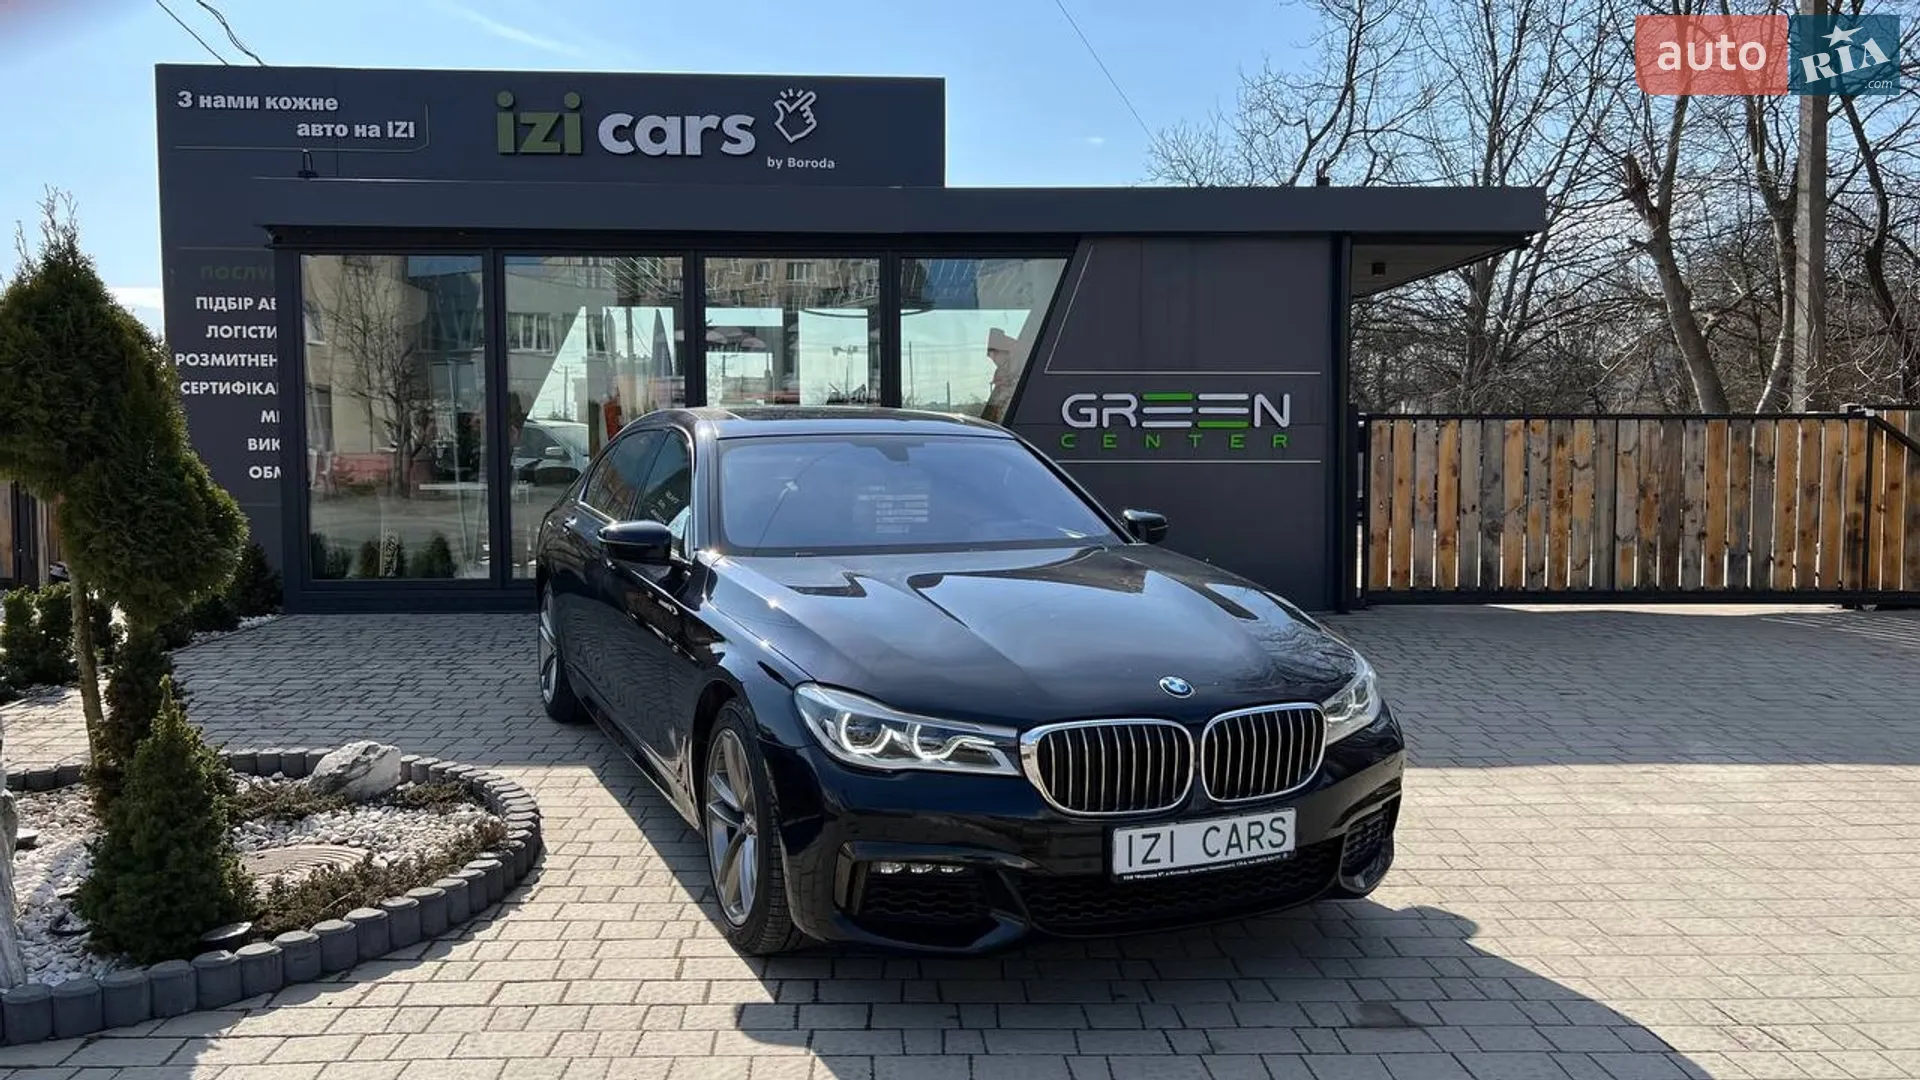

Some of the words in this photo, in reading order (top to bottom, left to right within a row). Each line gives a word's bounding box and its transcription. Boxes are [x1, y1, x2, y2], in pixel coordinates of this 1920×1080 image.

[177, 91, 193, 109] З
[199, 93, 260, 110] нами
[265, 95, 339, 112] кожне
[296, 121, 349, 138] авто
[354, 122, 382, 138] на
[387, 121, 416, 139] IZI
[496, 90, 583, 155] izi
[598, 112, 757, 156] cars
[766, 157, 783, 171] by
[787, 157, 836, 170] Boroda
[195, 296, 253, 313] ПІДБІР
[205, 325, 278, 340] ЛОГІСТИ
[180, 381, 279, 396] СЕРТИФІКА
[1061, 393, 1291, 428] GREEN
[247, 437, 281, 452] ВИК
[1060, 433, 1289, 449] CENTER
[1128, 830, 1175, 868] IZI
[1202, 816, 1288, 858] CARS
